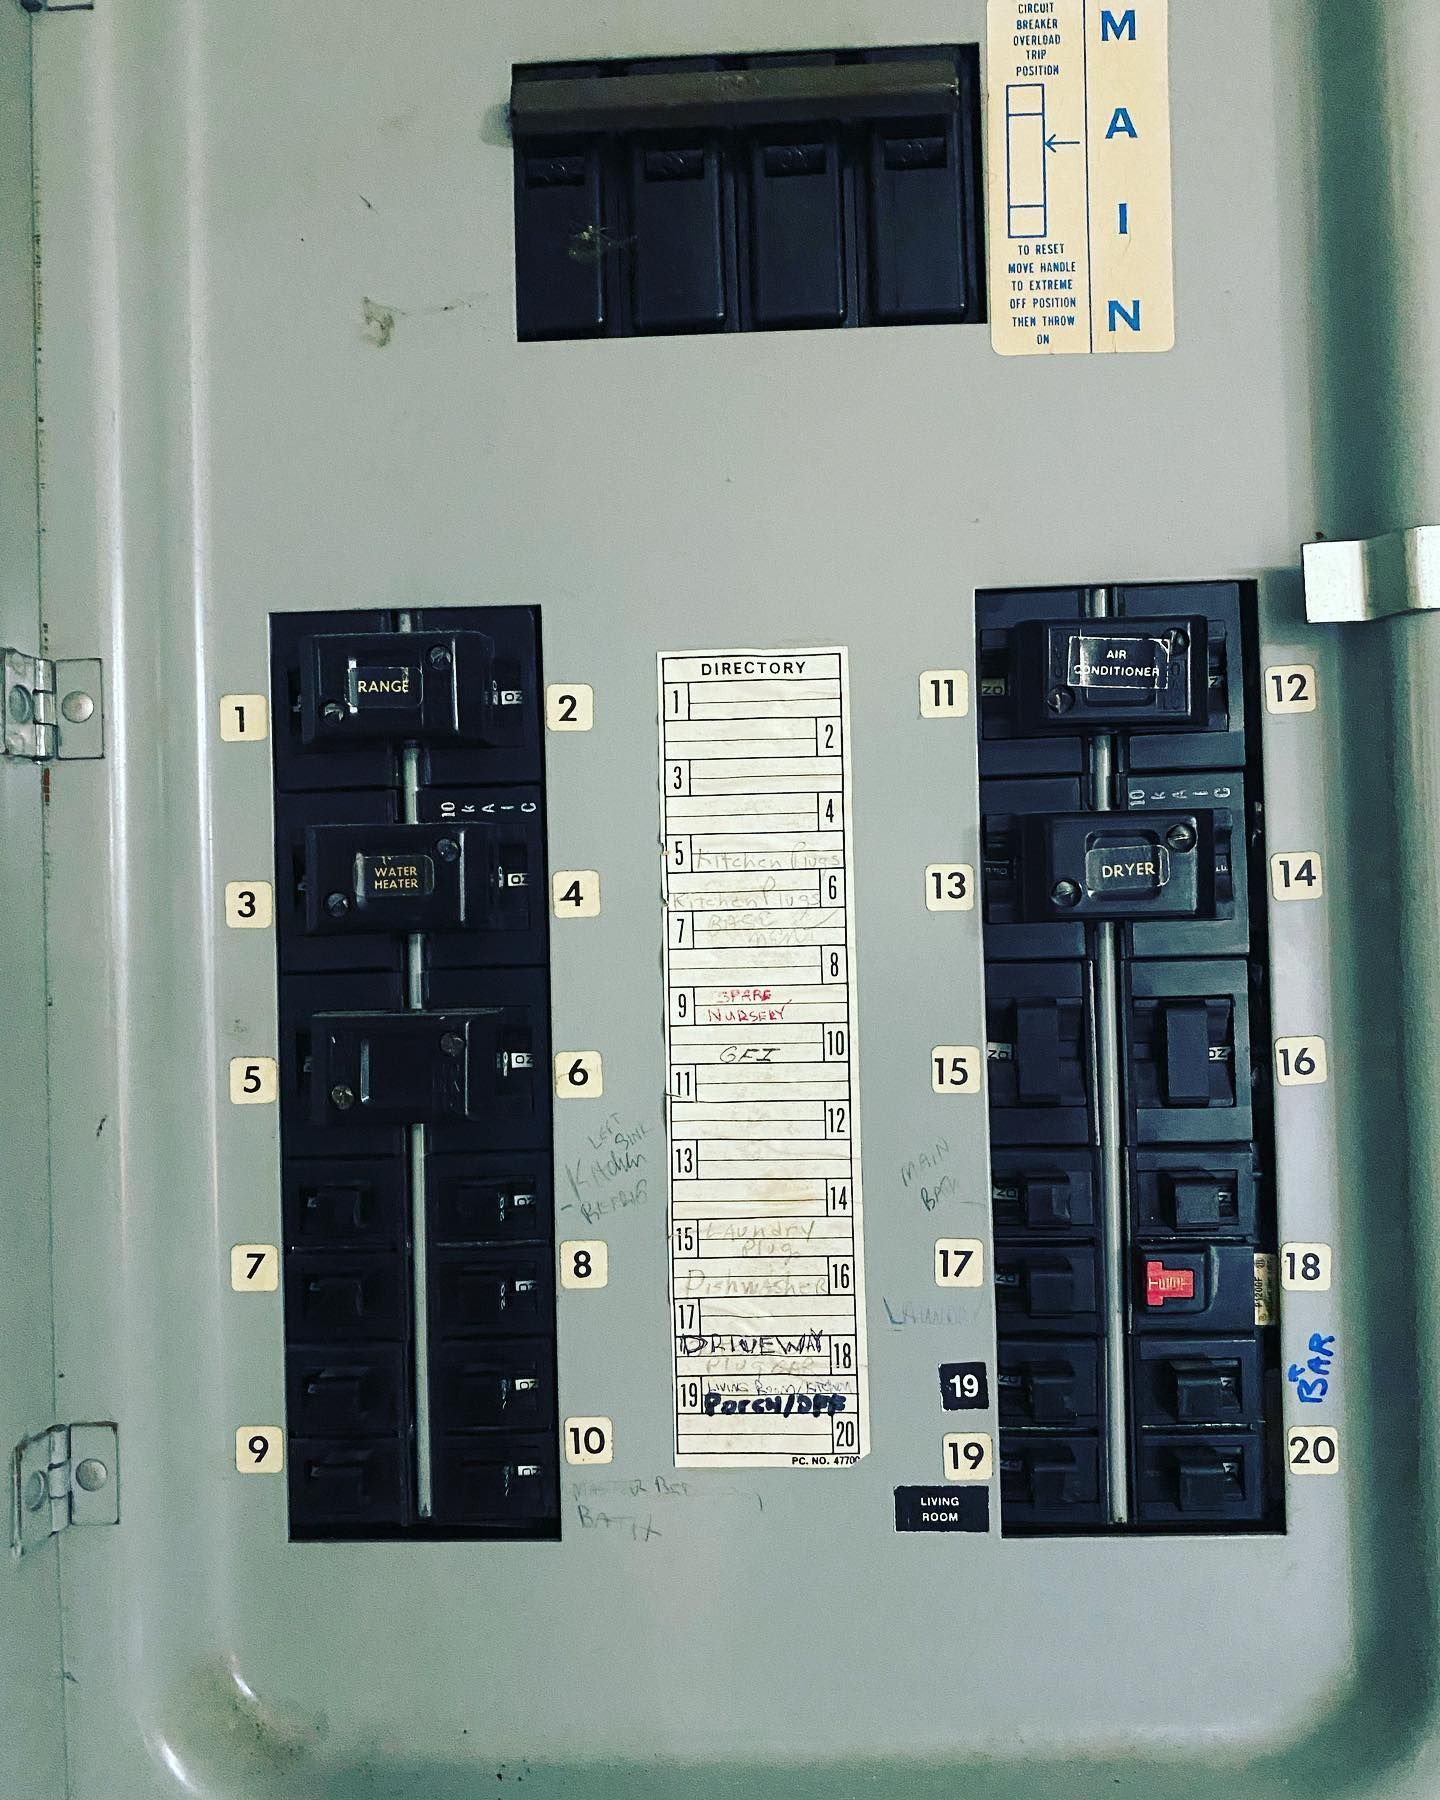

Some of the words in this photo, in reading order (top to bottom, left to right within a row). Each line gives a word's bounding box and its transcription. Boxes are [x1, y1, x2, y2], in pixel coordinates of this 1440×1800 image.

[1018, 2, 1054, 14] CIRCUIT
[1016, 18, 1058, 30] BREAKER
[1013, 34, 1061, 46] OVERLOAD
[1025, 49, 1047, 60] TRIP
[1016, 65, 1059, 77] POSITION
[1018, 244, 1030, 255] TO
[1036, 243, 1065, 255] RESET
[1008, 262, 1035, 274] MOVE
[1040, 261, 1076, 273] HANDLE
[1012, 281, 1024, 292] TO
[1029, 279, 1073, 291] EXTREME
[1010, 298, 1026, 309] OFF
[1033, 297, 1076, 308] POSITION
[1012, 317, 1037, 327] THEN
[1042, 315, 1075, 327] THROW
[1037, 334, 1050, 345] ON
[1106, 650, 1127, 659] AIR
[701, 661, 806, 676] DIRECTORY
[1074, 664, 1160, 677] CONDITIONER
[358, 680, 409, 694] RANGE
[931, 680, 953, 706] 11
[1271, 674, 1309, 702] 12
[559, 695, 577, 721] 2
[673, 690, 679, 714] 1
[235, 707, 244, 733] 1
[825, 724, 834, 748] 2
[673, 766, 682, 790] 3
[825, 799, 834, 823] 4
[675, 841, 684, 866] 5
[374, 866, 417, 878] WATER
[1102, 862, 1156, 878] DRYER
[1279, 860, 1317, 888] 14
[374, 878, 418, 890] HEATER
[560, 881, 584, 907] 4
[828, 875, 837, 900] 6
[932, 871, 966, 900] 13
[238, 891, 256, 918] 3
[676, 918, 685, 944] 7
[830, 952, 839, 977] 8
[678, 993, 687, 1018] 9
[827, 1030, 845, 1056] 10
[569, 1059, 588, 1086] 6
[935, 1058, 968, 1086] 15
[1280, 1048, 1316, 1075] 16
[244, 1066, 262, 1094] 5
[675, 1071, 691, 1097] 11
[827, 1106, 846, 1133] 12
[675, 1148, 692, 1173] 13
[830, 1186, 848, 1211] 14
[675, 1227, 693, 1251] 15
[247, 1254, 265, 1280] 7
[574, 1251, 592, 1278] 8
[832, 1263, 850, 1289] 16
[940, 1250, 973, 1278] 17
[1285, 1253, 1321, 1280] 18
[679, 1304, 695, 1330] 17
[679, 1328, 824, 1355] DRIVEWAY
[833, 1343, 852, 1369] 18
[680, 1382, 698, 1408] 19
[949, 1374, 979, 1398] 19
[570, 1427, 606, 1454] 10
[836, 1421, 855, 1447] 20
[249, 1436, 268, 1464] 9
[792, 1457, 808, 1465] PC.
[812, 1456, 829, 1465] NO.
[949, 1442, 983, 1470] 19
[1289, 1436, 1336, 1464] 20
[920, 1497, 960, 1507] LIVING
[922, 1511, 959, 1522] ROOM
